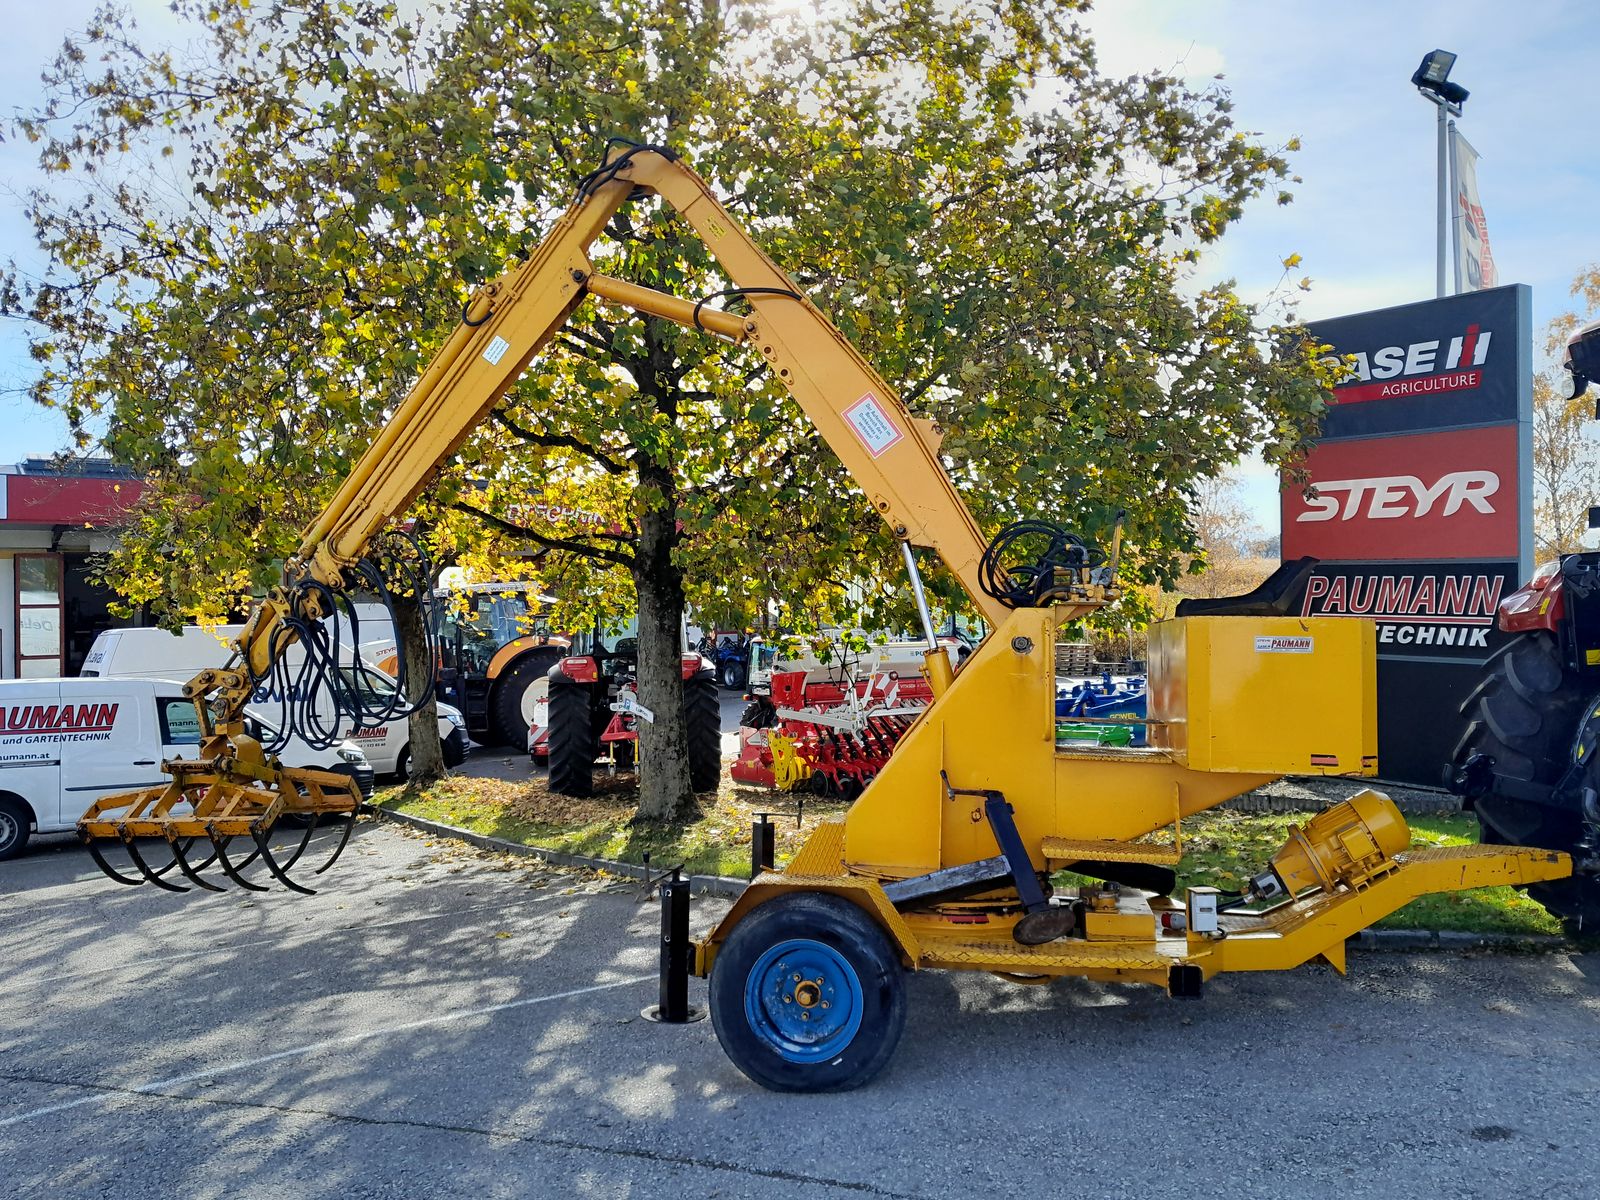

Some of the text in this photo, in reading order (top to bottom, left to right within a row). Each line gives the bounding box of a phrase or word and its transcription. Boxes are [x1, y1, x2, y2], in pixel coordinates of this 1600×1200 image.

[1381, 373, 1477, 397] AGRICULTURE
[1296, 470, 1500, 522] STEYR
[1301, 576, 1504, 617] PAUMANN
[1271, 640, 1311, 648] PAUMANN
[1376, 625, 1491, 647] ECHNIK
[2, 732, 111, 745] und GARTENTECHNIK
